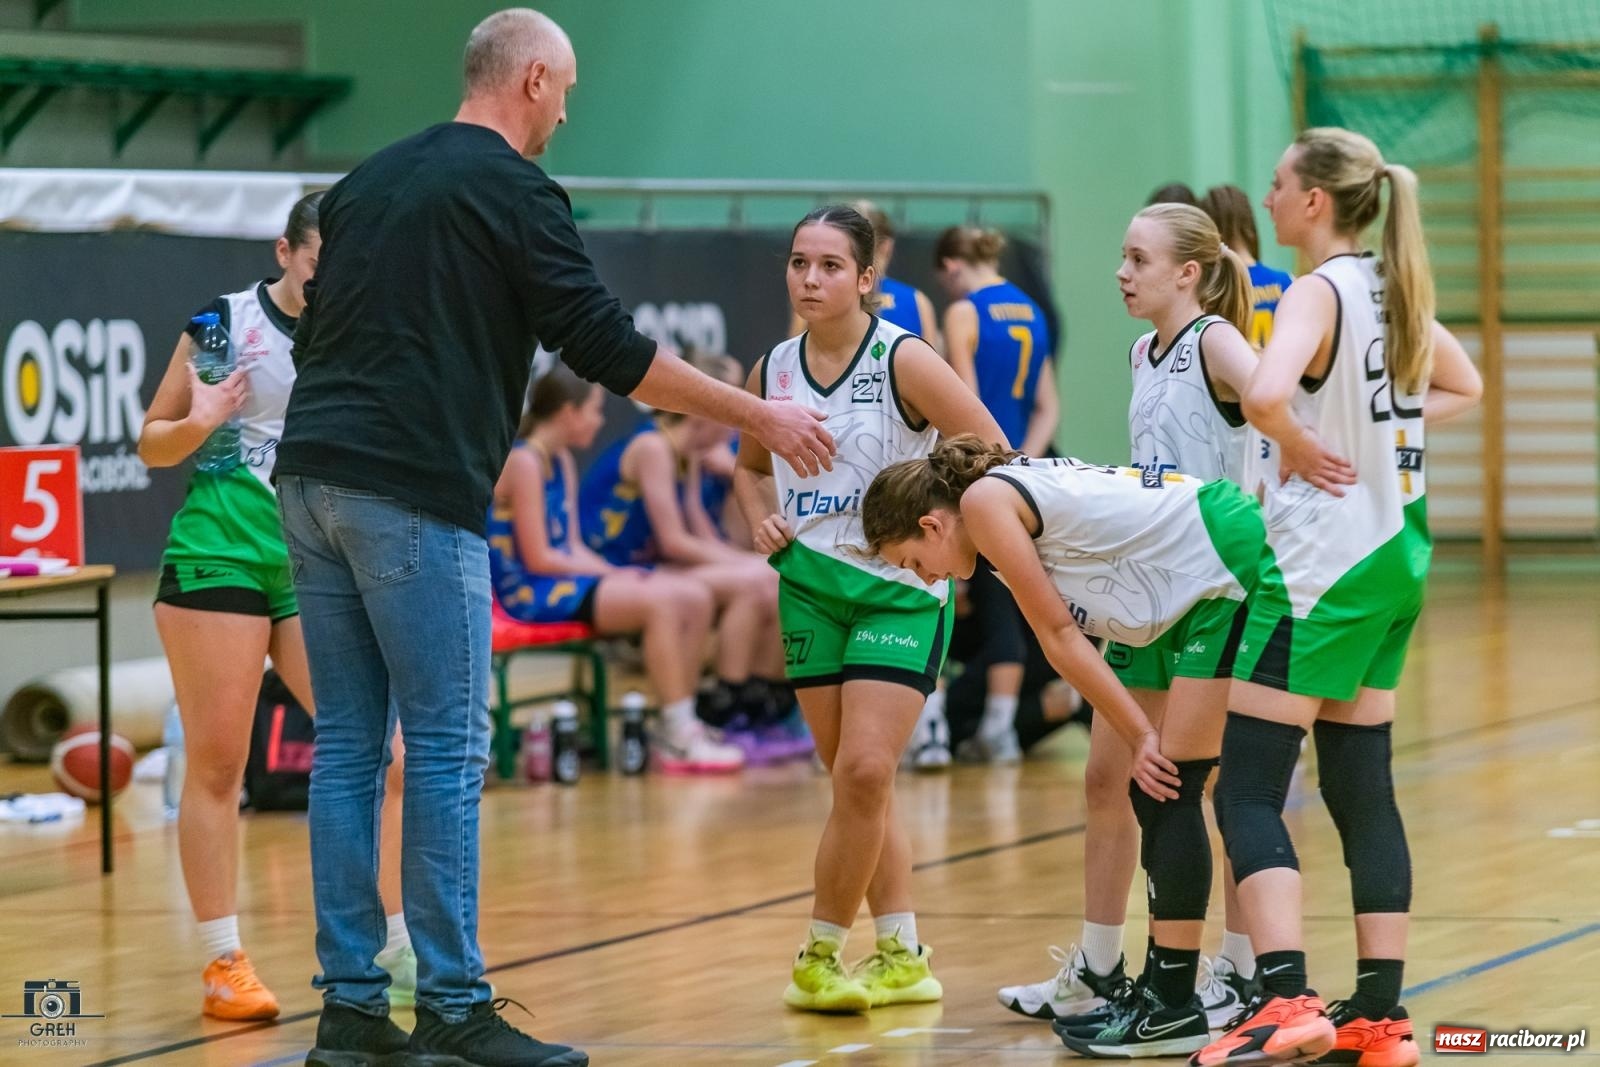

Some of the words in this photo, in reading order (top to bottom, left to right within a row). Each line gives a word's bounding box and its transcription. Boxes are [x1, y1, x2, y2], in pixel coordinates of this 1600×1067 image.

[1008, 325, 1034, 399] 7
[851, 371, 887, 403] 27
[11, 459, 62, 542] 5
[796, 488, 861, 517] Clavi
[781, 630, 815, 664] 27
